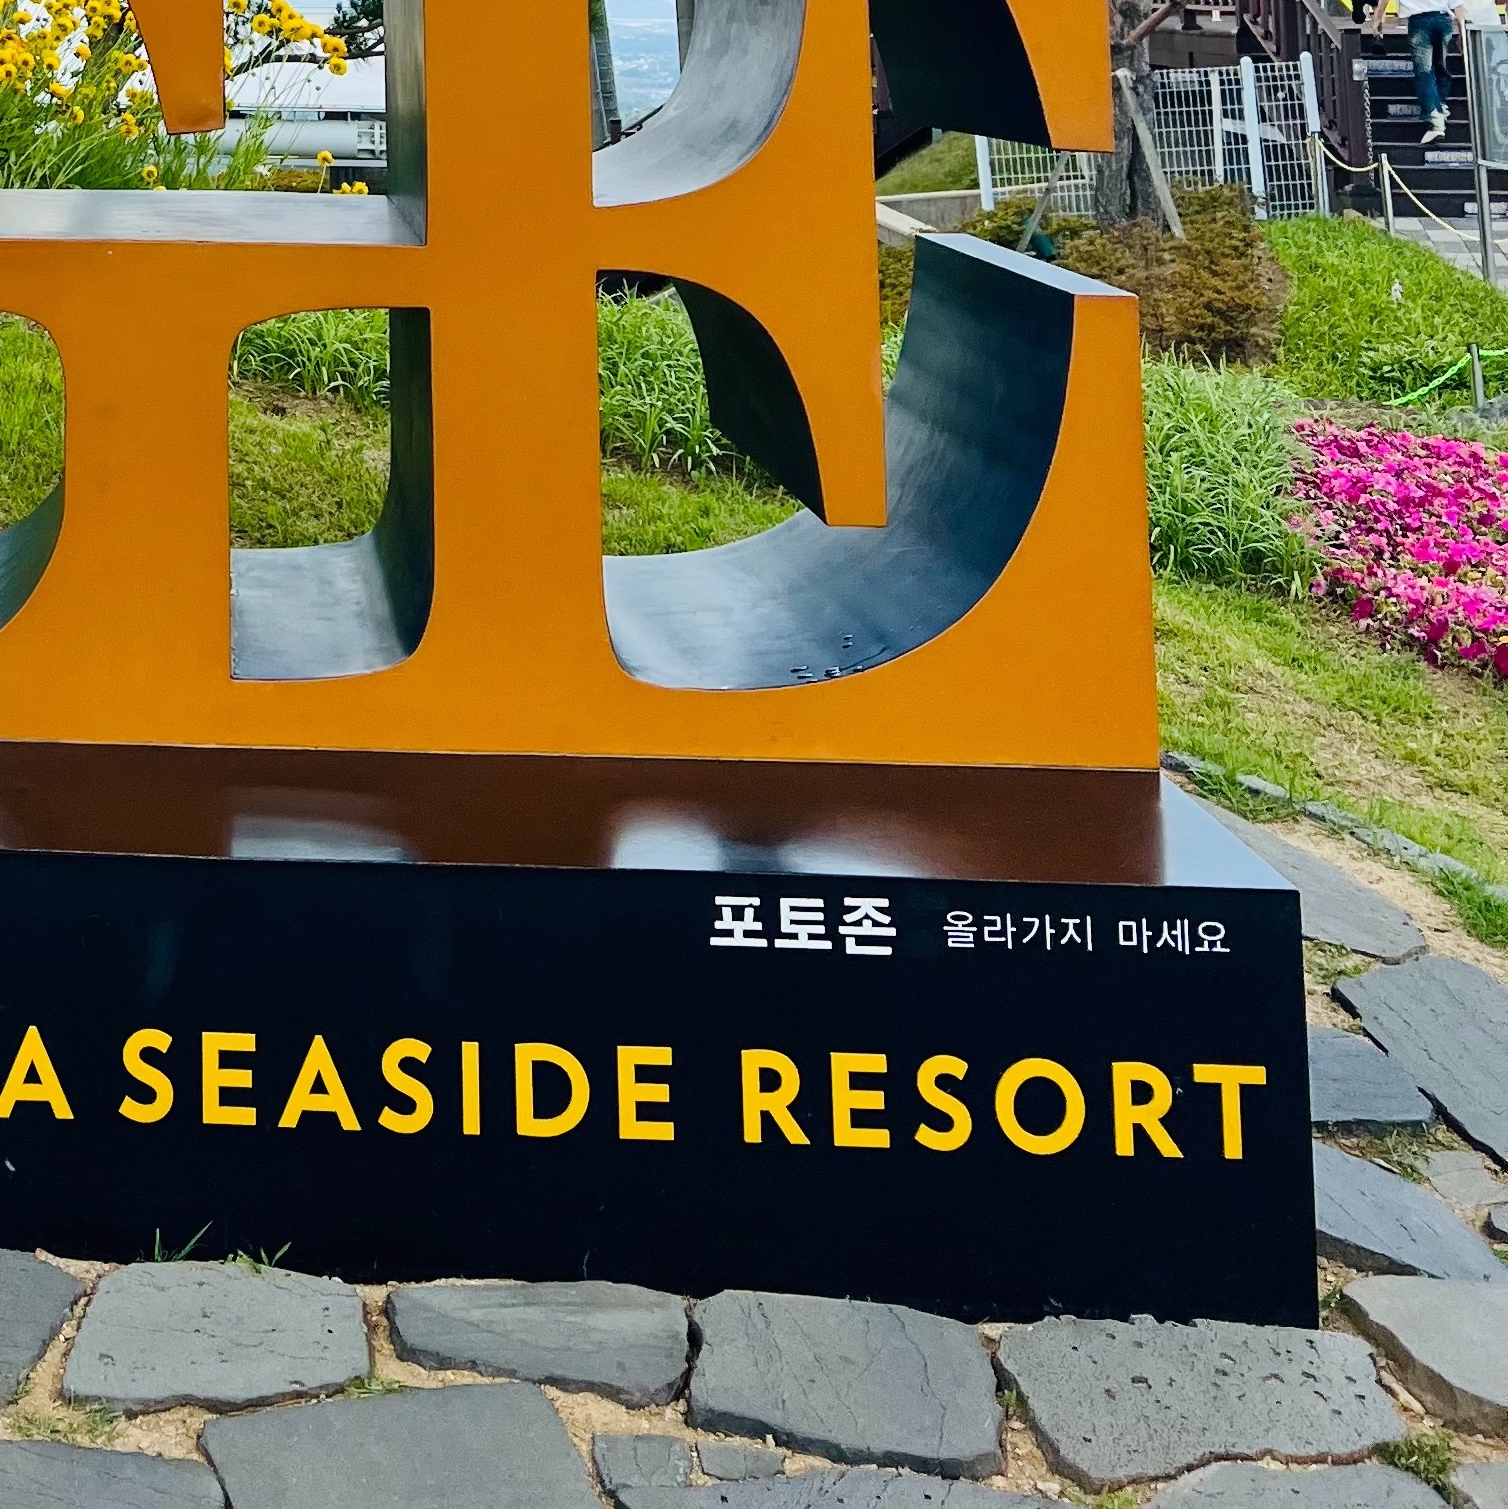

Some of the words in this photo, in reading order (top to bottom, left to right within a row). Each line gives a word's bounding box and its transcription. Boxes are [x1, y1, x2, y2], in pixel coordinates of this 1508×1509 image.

[709, 895, 897, 956] 포토존
[942, 910, 1094, 952] 올라가지
[1118, 917, 1232, 955] 마세요
[118, 1028, 676, 1141] SEASIDE
[740, 1048, 1267, 1160] RESORT
